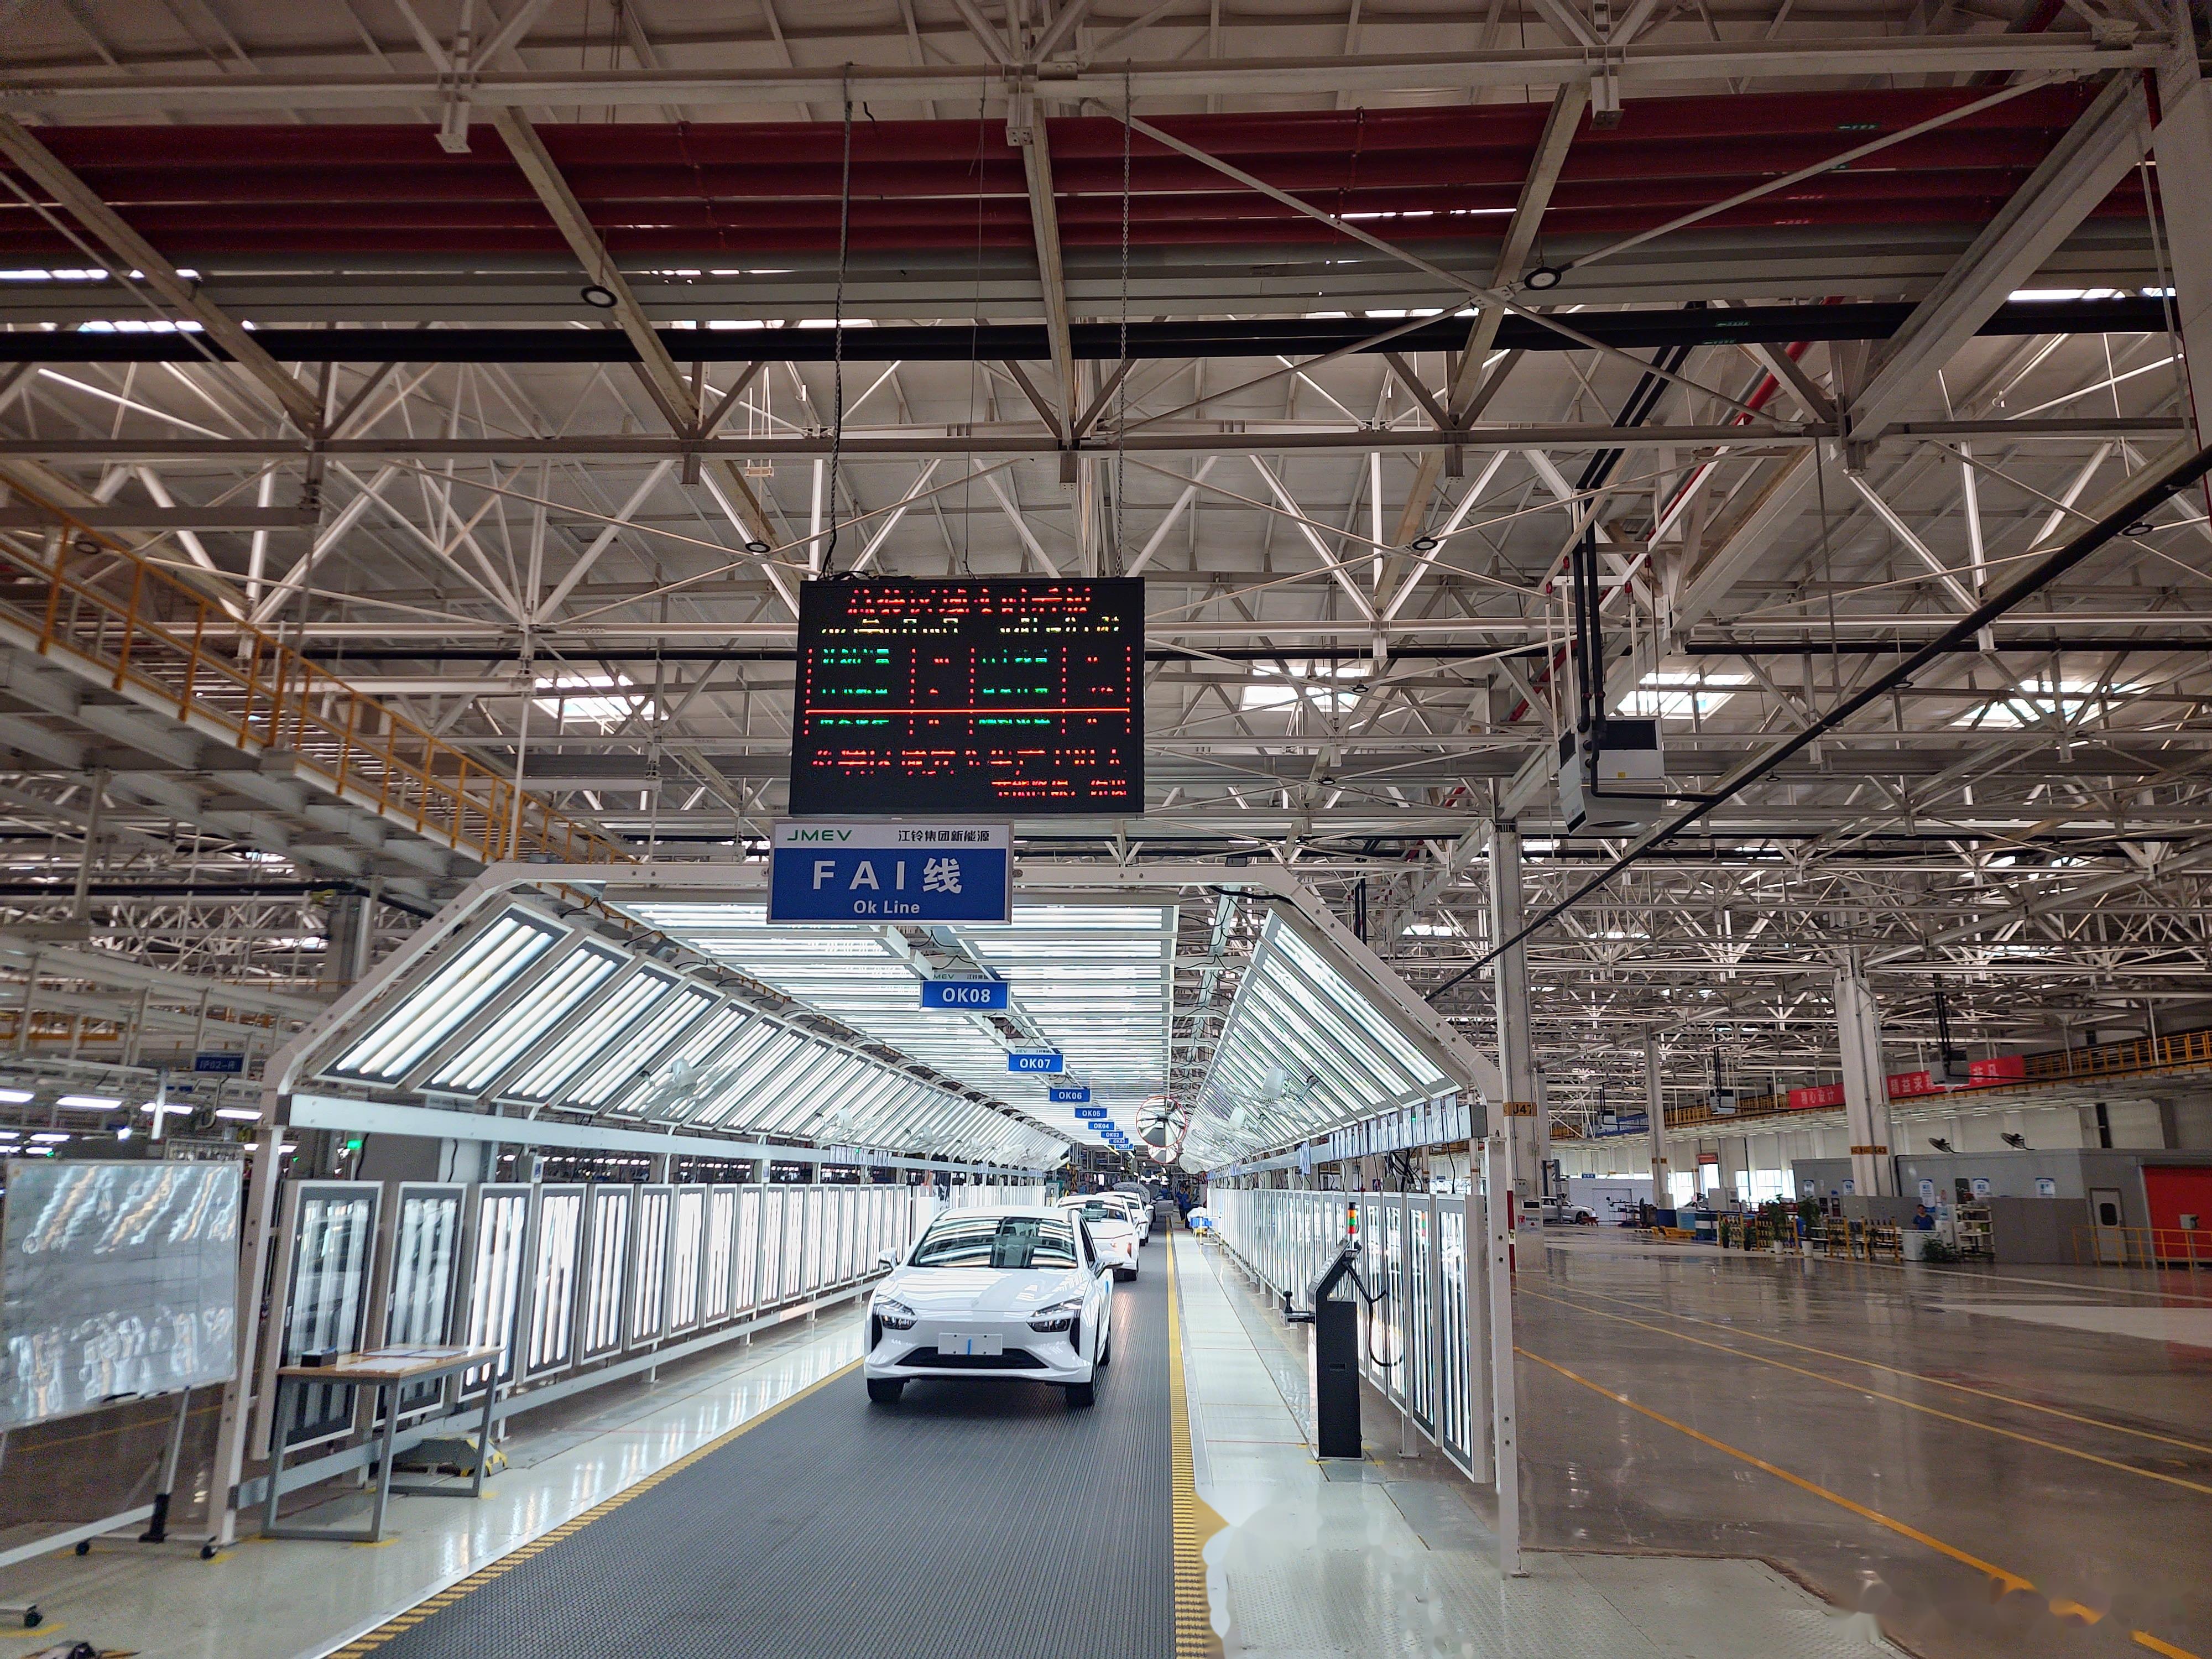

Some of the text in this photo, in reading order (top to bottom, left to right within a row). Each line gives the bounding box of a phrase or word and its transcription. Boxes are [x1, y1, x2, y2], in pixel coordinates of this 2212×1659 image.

[787, 830, 852, 841] JMEV
[898, 830, 990, 842] 江铃集团新能源
[853, 899, 920, 914] Ok Line
[942, 987, 990, 1003] OK08
[1019, 1058, 1051, 1069] OK07
[1513, 1104, 1532, 1114] J47
